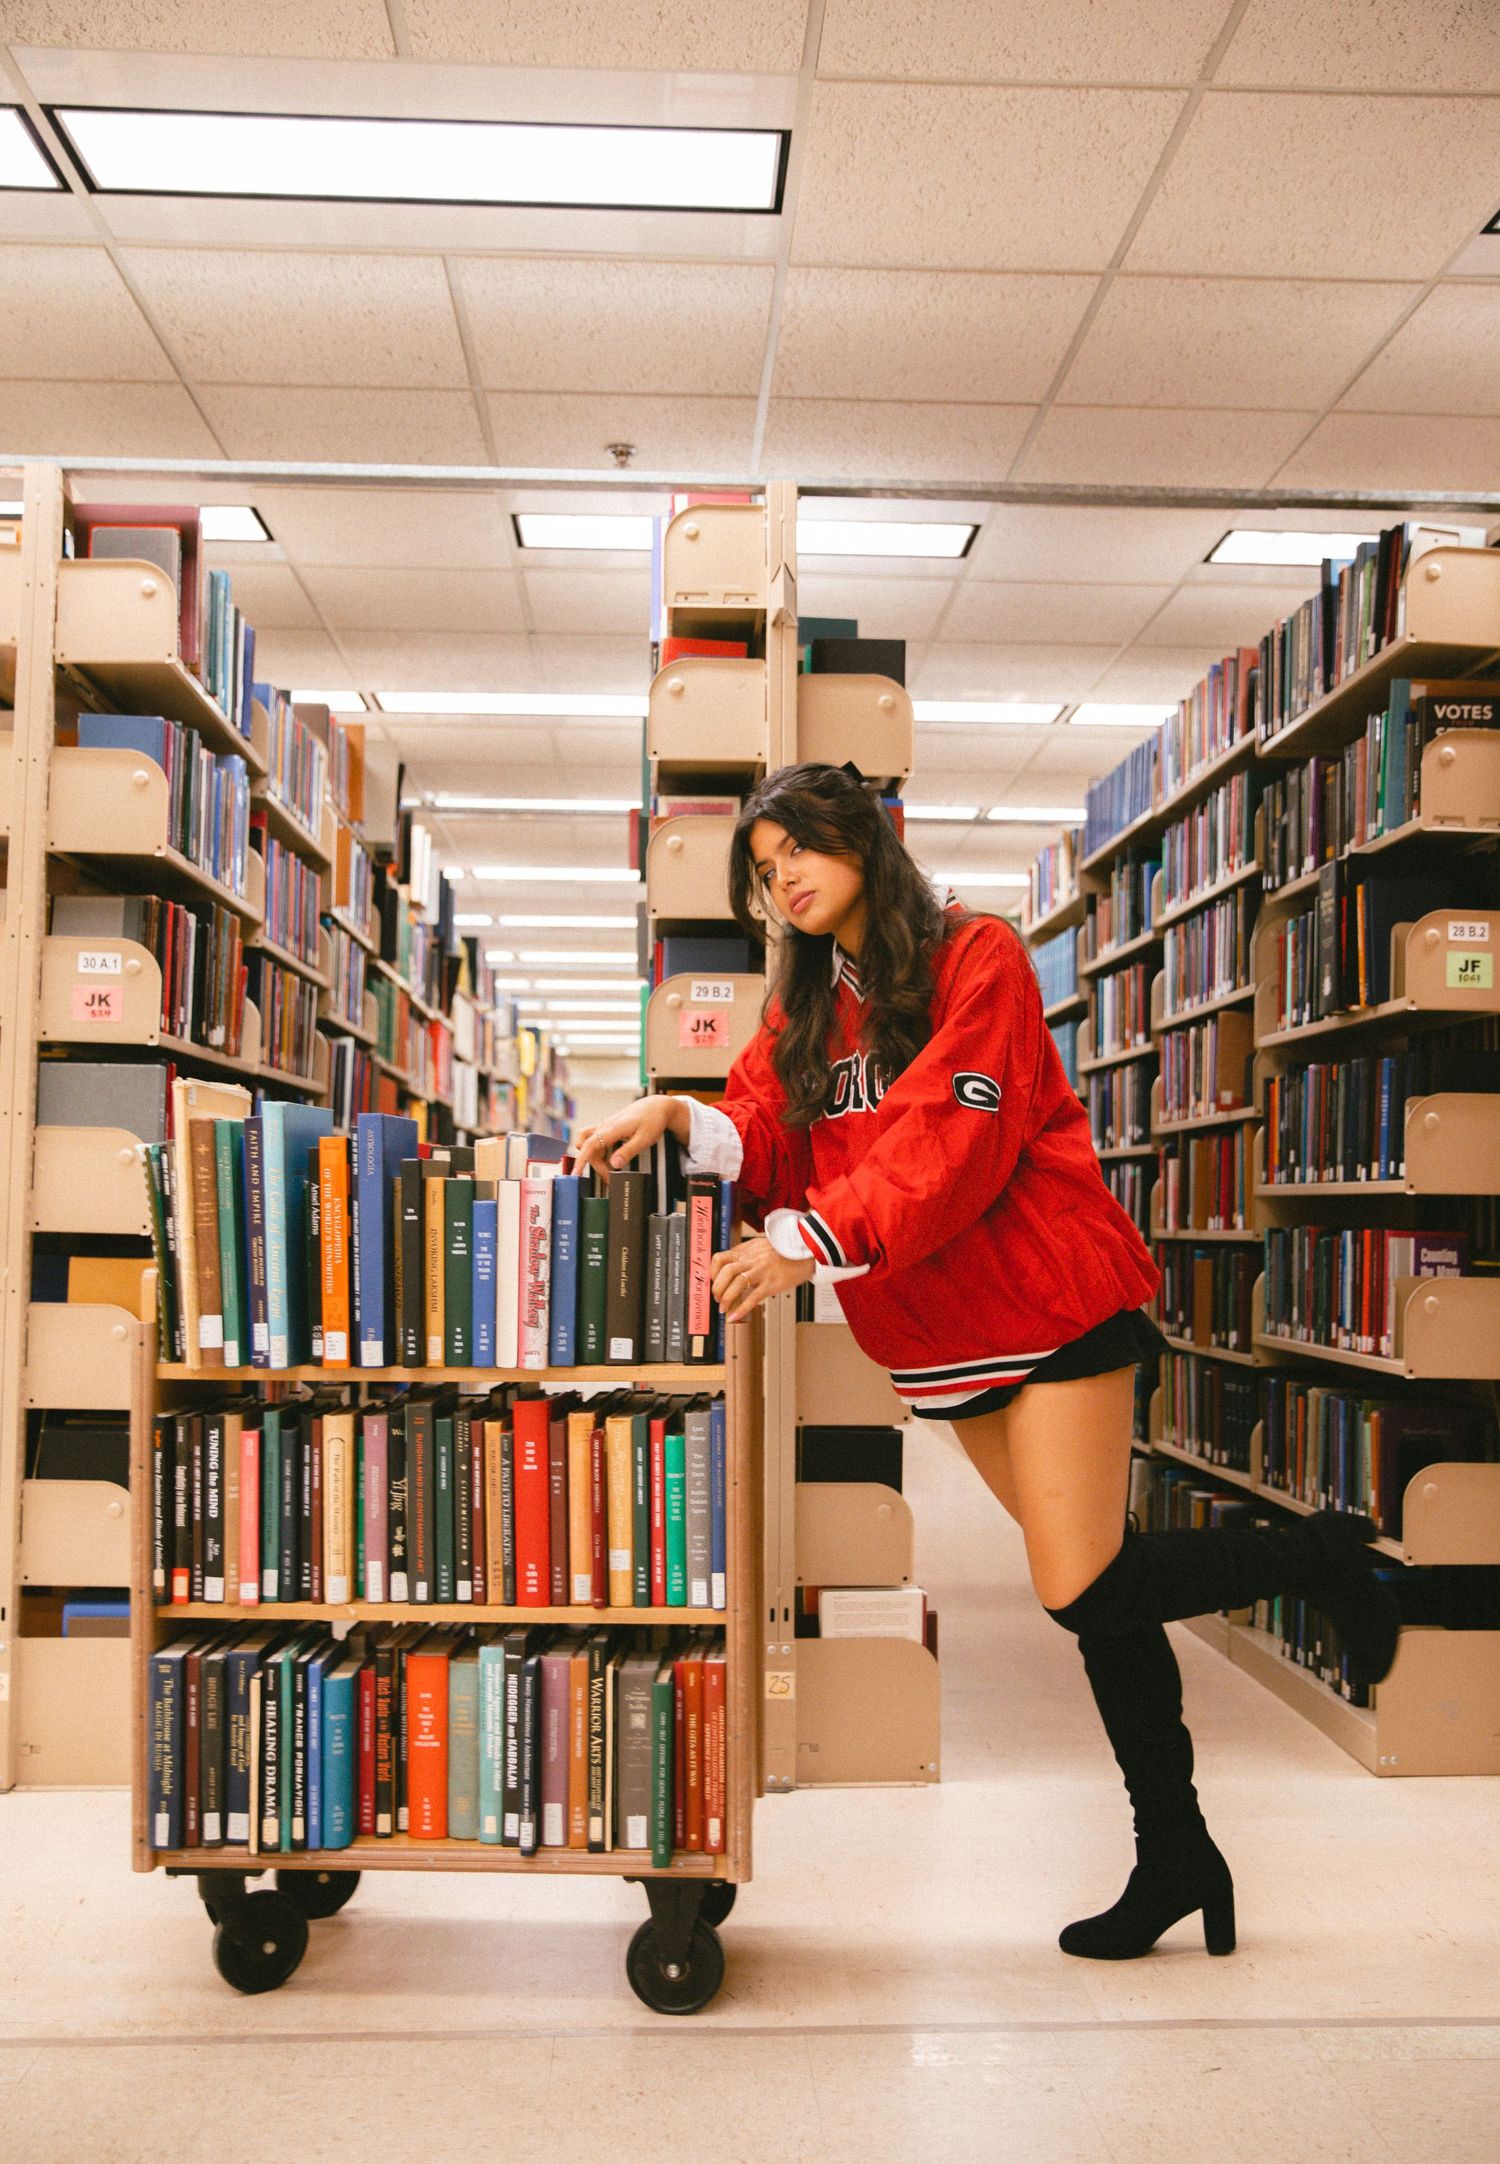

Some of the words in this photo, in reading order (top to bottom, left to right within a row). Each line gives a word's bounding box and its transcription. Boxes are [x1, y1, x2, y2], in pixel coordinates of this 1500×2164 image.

[1434, 704, 1493, 720] VOTES
[1453, 926, 1465, 937] 28
[1469, 926, 1486, 938] B.2
[83, 957, 96, 969] 30
[100, 957, 119, 970] A.1
[1459, 960, 1481, 973] JF
[85, 994, 111, 1007] JK
[696, 986, 709, 997] 29
[712, 987, 731, 998] B.2
[690, 1019, 716, 1032] JK
[952, 1071, 1002, 1112] G
[250, 1130, 260, 1158] FAITH
[251, 1164, 260, 1185] AND
[270, 1168, 282, 1184] The
[324, 1168, 332, 1182] OF
[311, 1182, 320, 1207] Ansel
[252, 1190, 262, 1225] EMPIRE
[312, 1208, 320, 1236] Adams
[696, 1200, 708, 1254] Handbook
[272, 1242, 281, 1282] Ancient
[1420, 1248, 1458, 1265] Counting
[693, 1271, 707, 1331] Forgiveness
[208, 1428, 219, 1470] TUNING
[154, 1452, 163, 1474] Western
[502, 1458, 510, 1466] A
[208, 1472, 219, 1486] the
[502, 1468, 510, 1491] PATH
[208, 1488, 219, 1518] MIND
[416, 1488, 424, 1496] IN
[502, 1494, 511, 1507] TO
[154, 1506, 163, 1518] and
[175, 1504, 187, 1527] Holocaust
[416, 1498, 424, 1558] CONTEMPORARY
[502, 1508, 512, 1566] LIBERATION
[416, 1559, 424, 1574] ART
[164, 1678, 174, 1696] The
[207, 1676, 218, 1710] BRUCE
[377, 1676, 391, 1696] Witch
[768, 1676, 791, 1694] 25
[507, 1674, 518, 1723] HEIDEGGER
[591, 1677, 604, 1732] WARRIOR
[154, 1701, 163, 1728] MAGIC
[163, 1698, 174, 1742] Bathhouse
[207, 1712, 218, 1730] LEE
[296, 1702, 304, 1748] TRANCE
[154, 1731, 163, 1741] IN
[237, 1728, 246, 1750] Images
[265, 1700, 277, 1761] HEALING
[154, 1742, 163, 1771] RUSSIA
[163, 1744, 172, 1753] at
[377, 1733, 391, 1759] Western
[591, 1736, 604, 1764] ARTS
[689, 1750, 696, 1759] AS
[160, 1754, 173, 1794] Midnight
[377, 1762, 391, 1782] World
[506, 1739, 517, 1788] KABBALAH
[689, 1760, 696, 1768] IT
[295, 1752, 303, 1816] FORMATION
